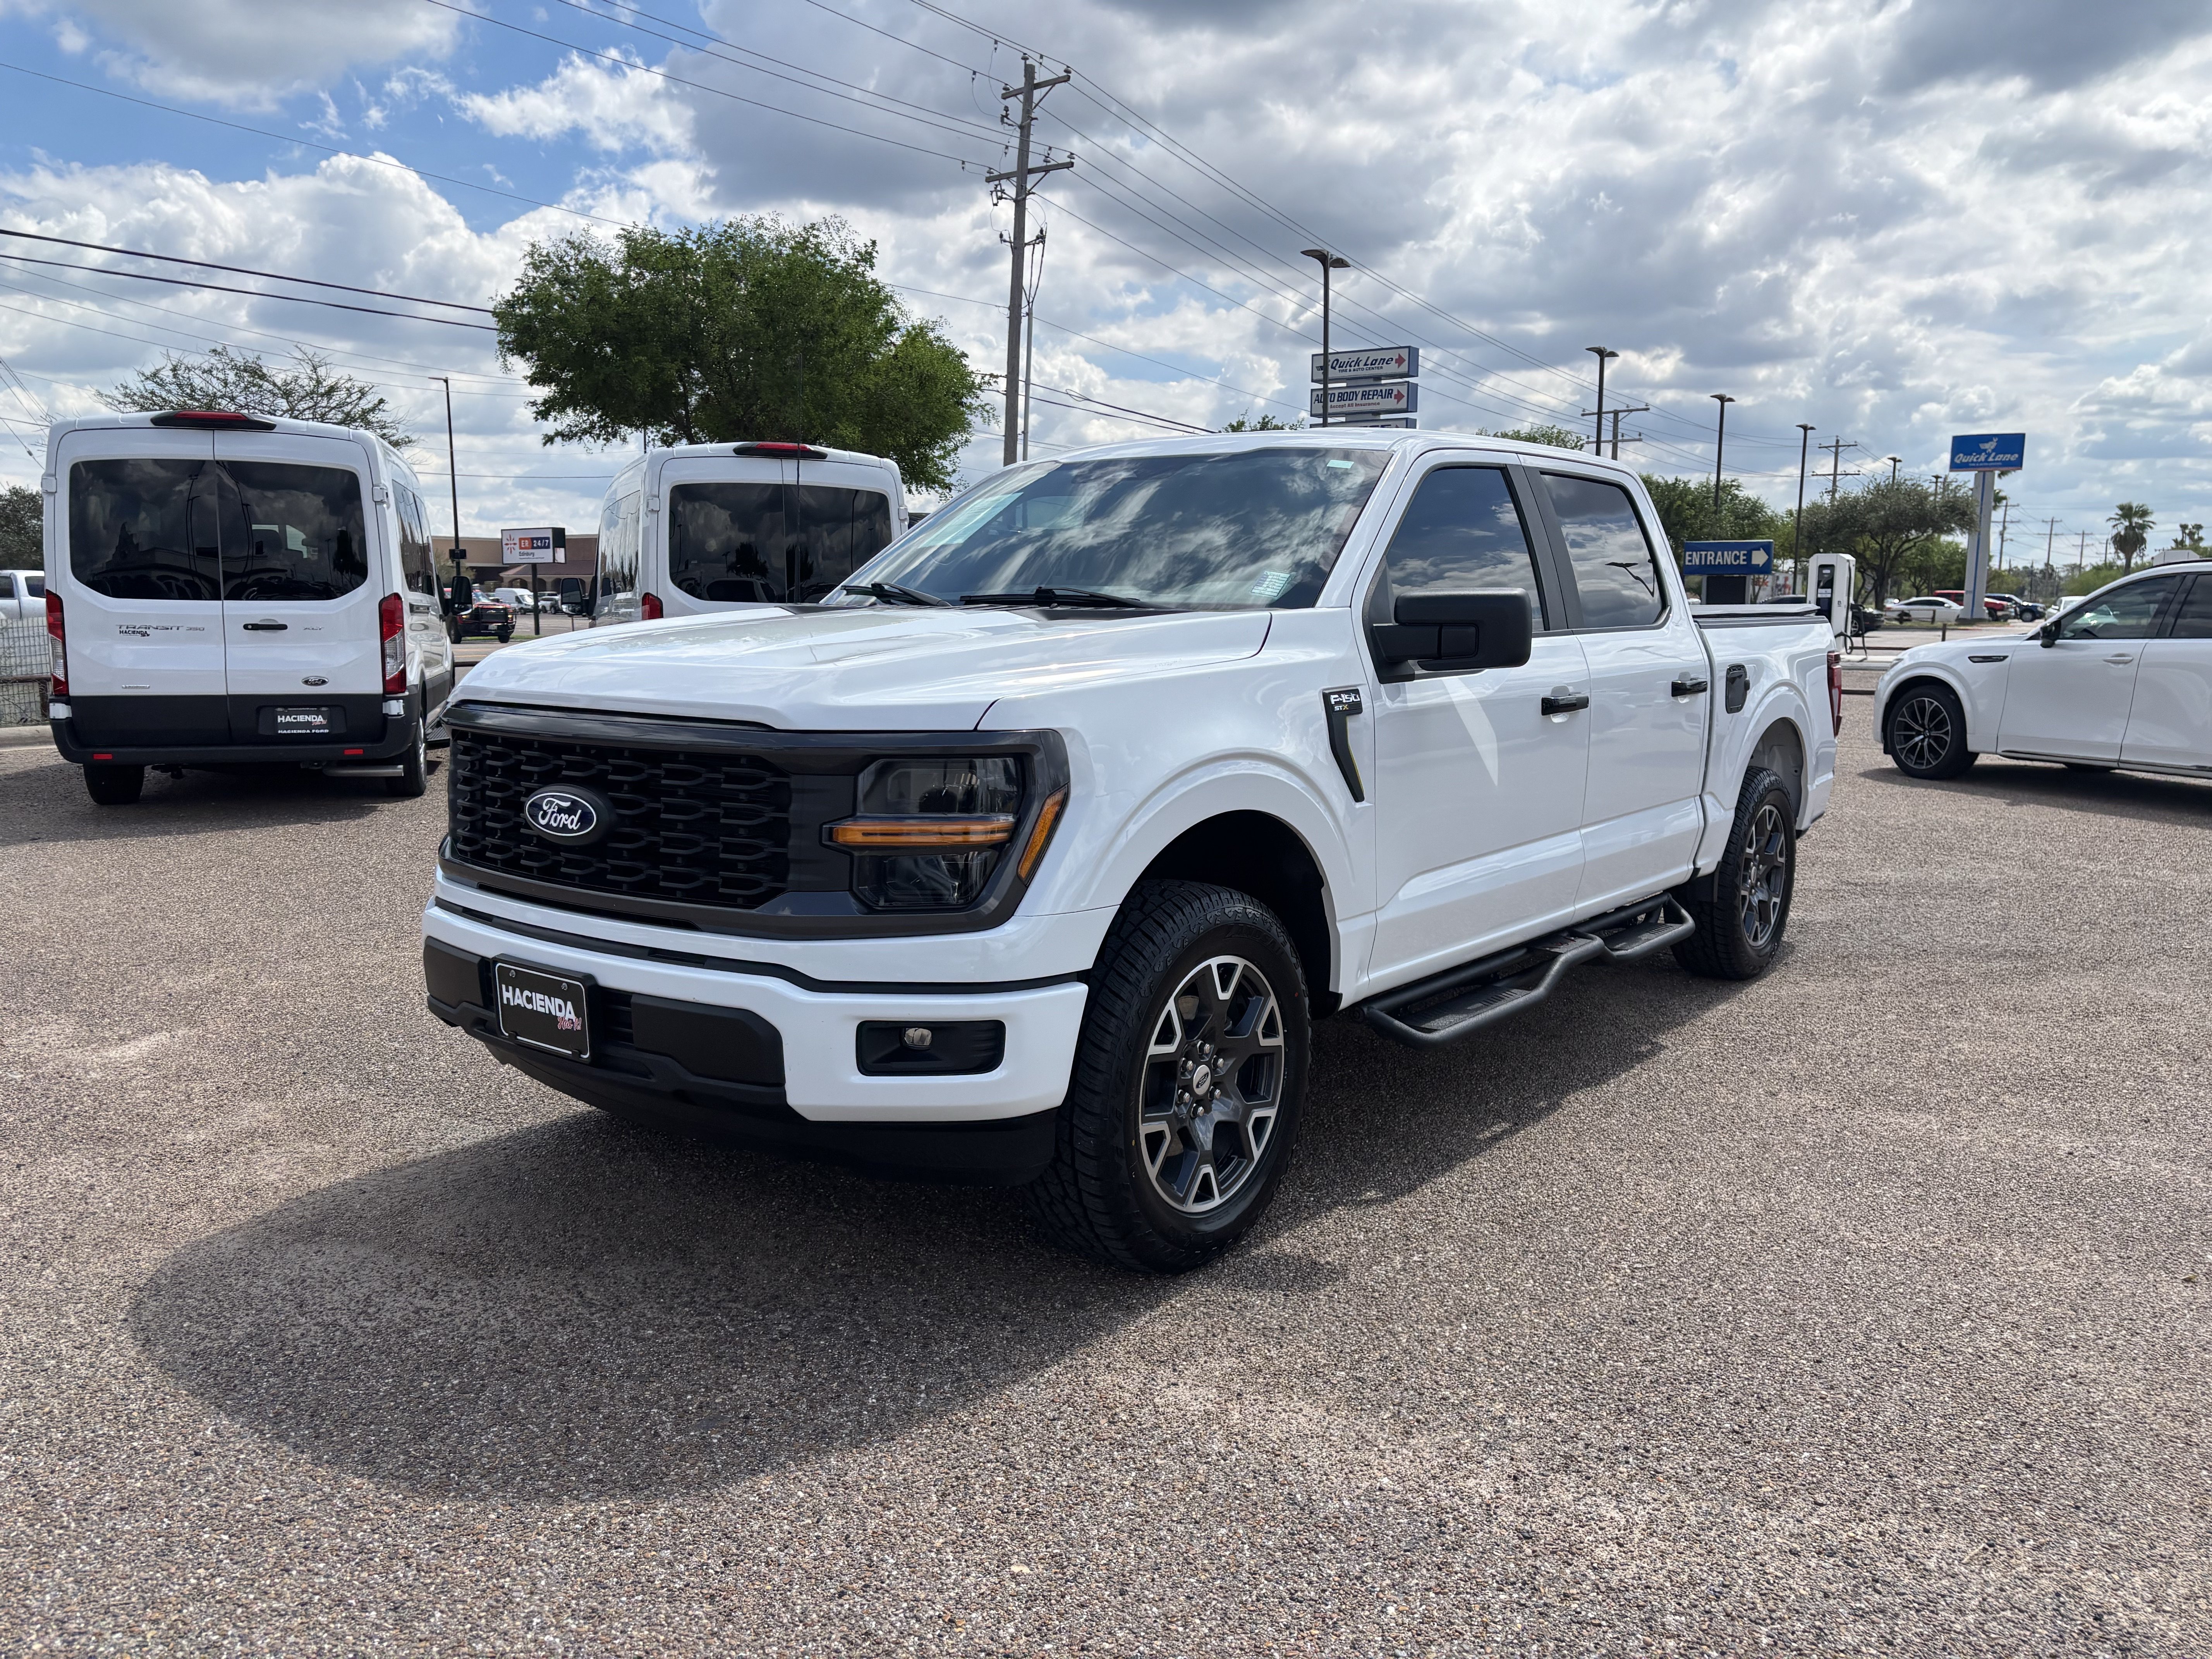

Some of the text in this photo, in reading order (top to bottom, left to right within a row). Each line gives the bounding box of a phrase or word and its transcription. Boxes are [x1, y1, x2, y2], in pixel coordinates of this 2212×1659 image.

[1331, 356, 1394, 370] Quick Lane
[1337, 390, 1359, 402] BODY
[1361, 388, 1393, 400] REPAIR
[1954, 452, 2019, 463] Quick Lane
[1685, 551, 1747, 565] ENTRANCE
[538, 798, 582, 830] Ford
[502, 984, 576, 1022] HACIENDA
